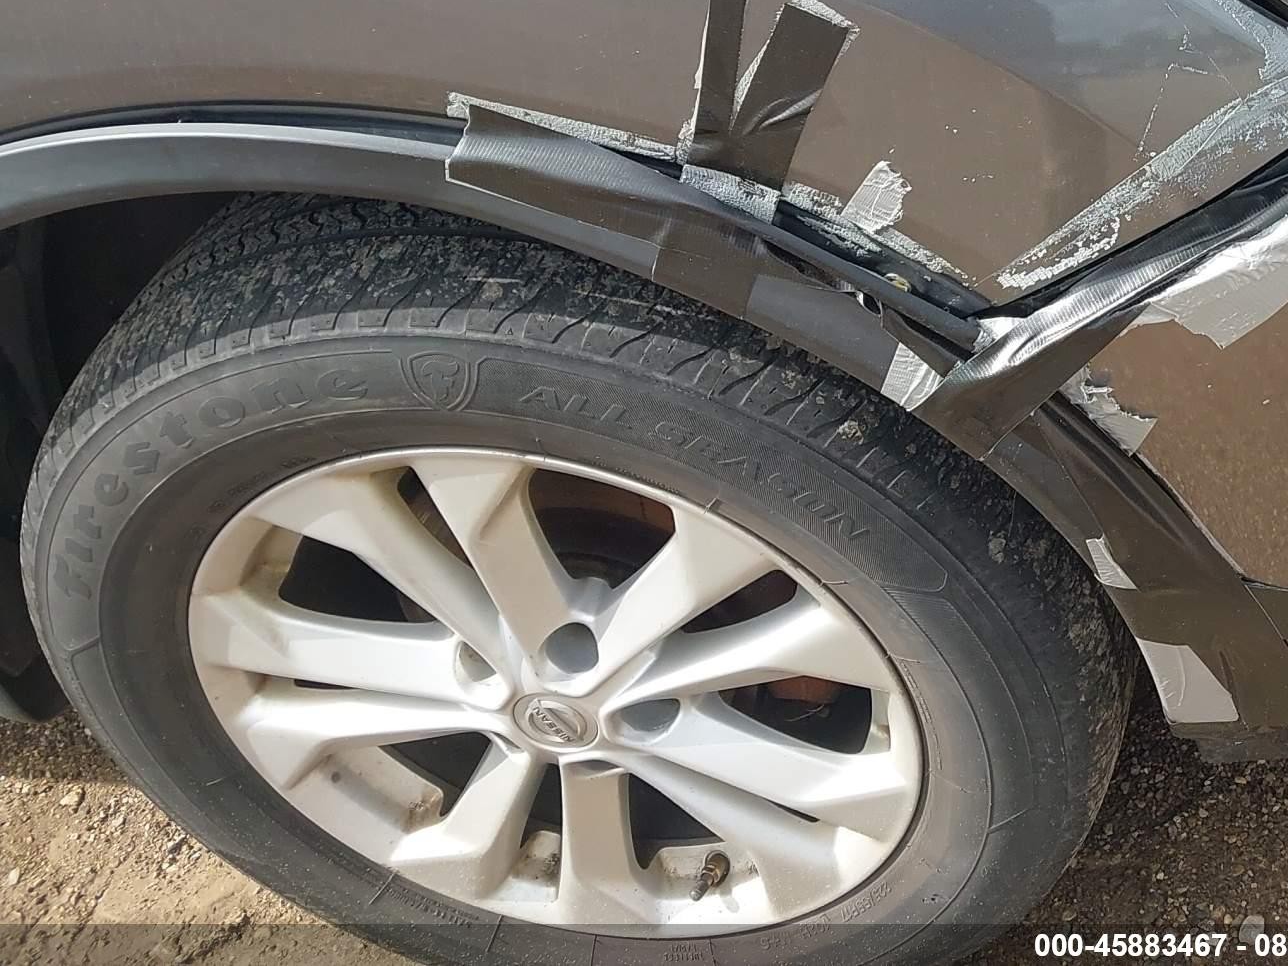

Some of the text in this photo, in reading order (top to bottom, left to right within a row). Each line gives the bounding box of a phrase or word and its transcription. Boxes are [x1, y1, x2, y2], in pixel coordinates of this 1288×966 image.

[520, 385, 632, 429] ALL
[651, 420, 870, 539] SEASON
[533, 706, 575, 742] NISSAN
